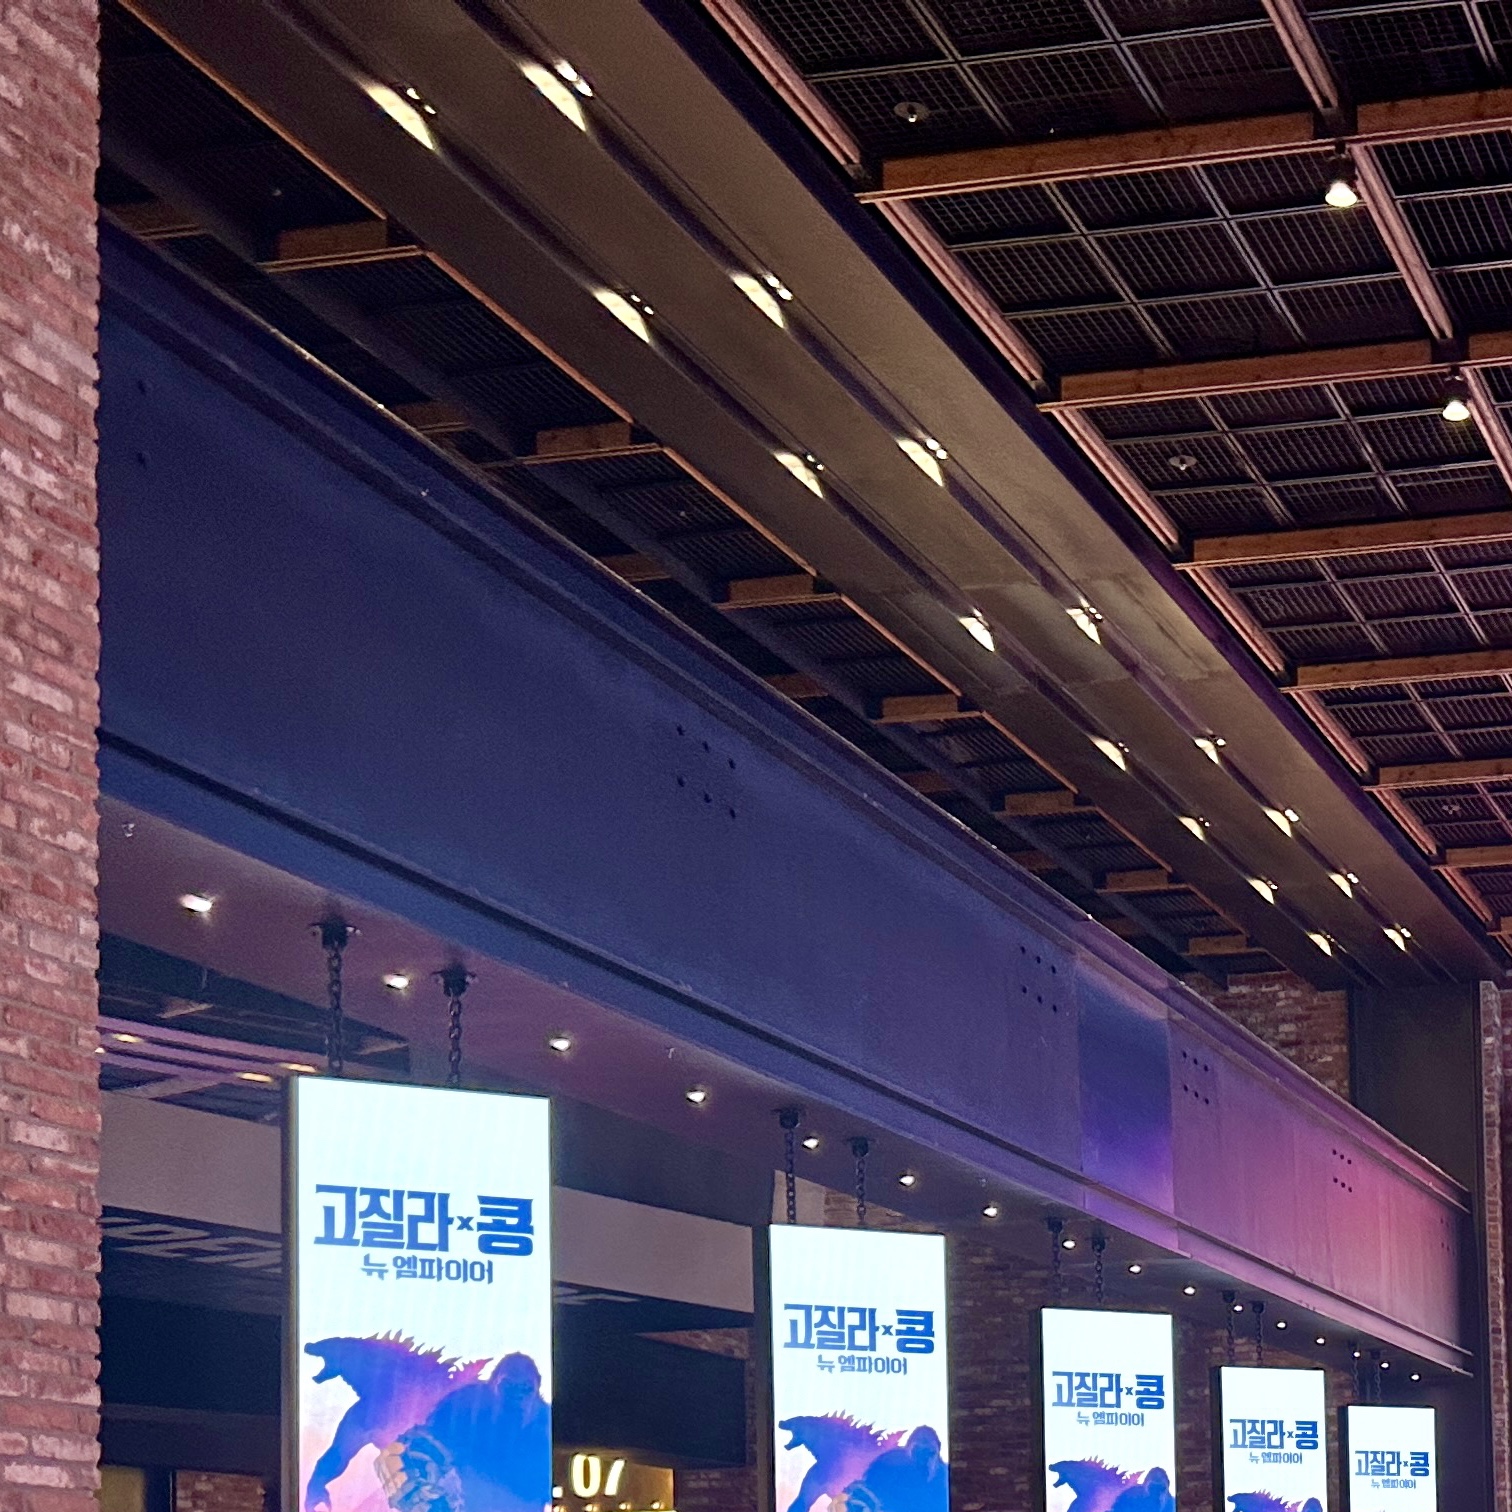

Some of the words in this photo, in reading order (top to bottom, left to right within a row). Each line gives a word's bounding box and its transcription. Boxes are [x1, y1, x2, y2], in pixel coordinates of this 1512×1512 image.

[360, 1253, 389, 1281] 뉴
[392, 1254, 493, 1285] 엠파이어
[816, 1354, 835, 1374] 뉴
[837, 1355, 908, 1376] 엠파이어
[1076, 1411, 1090, 1426] 뉴
